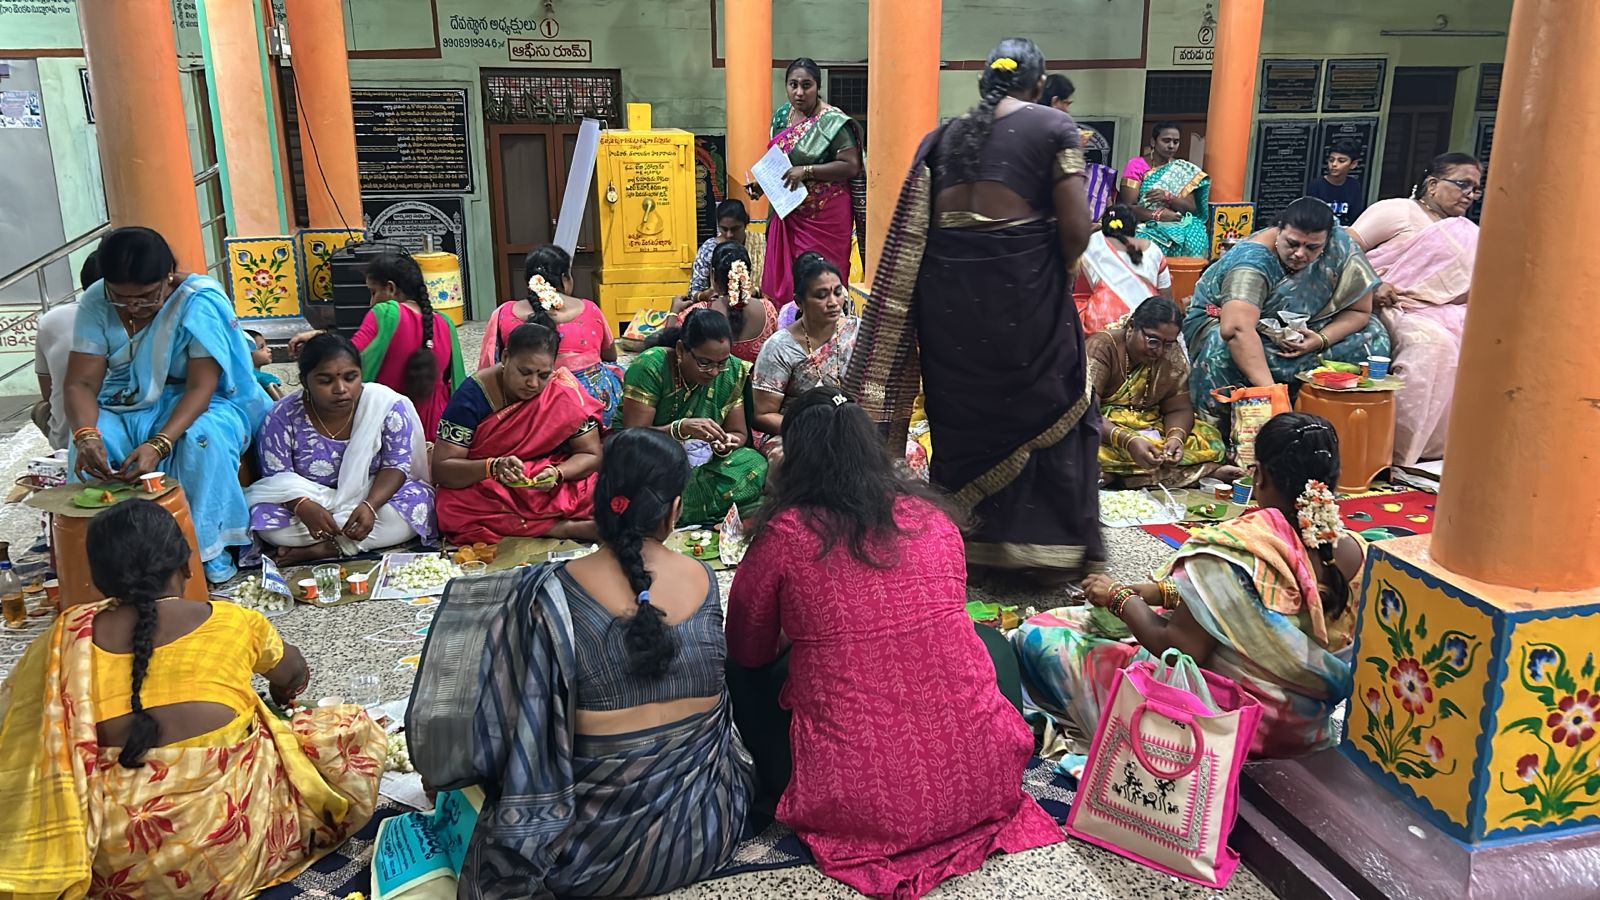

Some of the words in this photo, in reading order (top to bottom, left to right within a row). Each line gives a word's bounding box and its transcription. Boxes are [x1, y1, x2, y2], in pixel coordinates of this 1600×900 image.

[450, 15, 488, 35] దేవస్థాన
[490, 17, 537, 35] అధ్యక్షులు
[1202, 28, 1210, 42] 2
